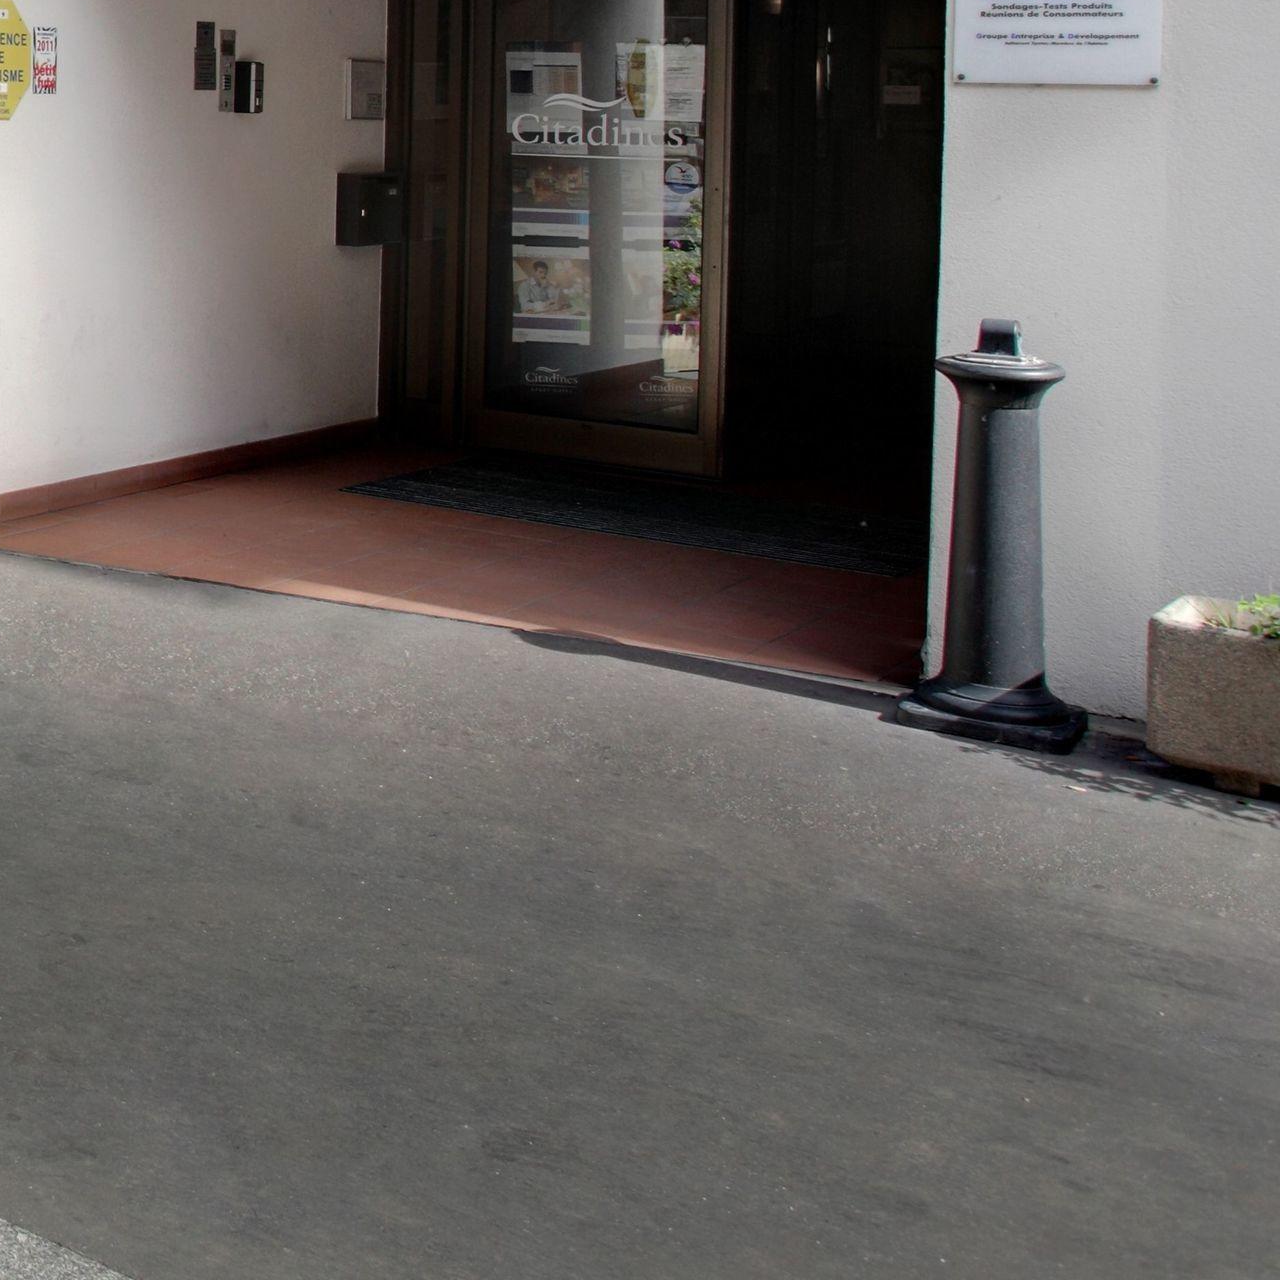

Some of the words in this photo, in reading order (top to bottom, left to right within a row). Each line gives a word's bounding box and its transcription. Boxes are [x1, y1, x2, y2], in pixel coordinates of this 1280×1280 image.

[1043, 10, 1124, 18] Consommateurs
[37, 40, 53, 52] 2011
[525, 371, 578, 385] Citadines
[639, 381, 695, 393] Citadines
